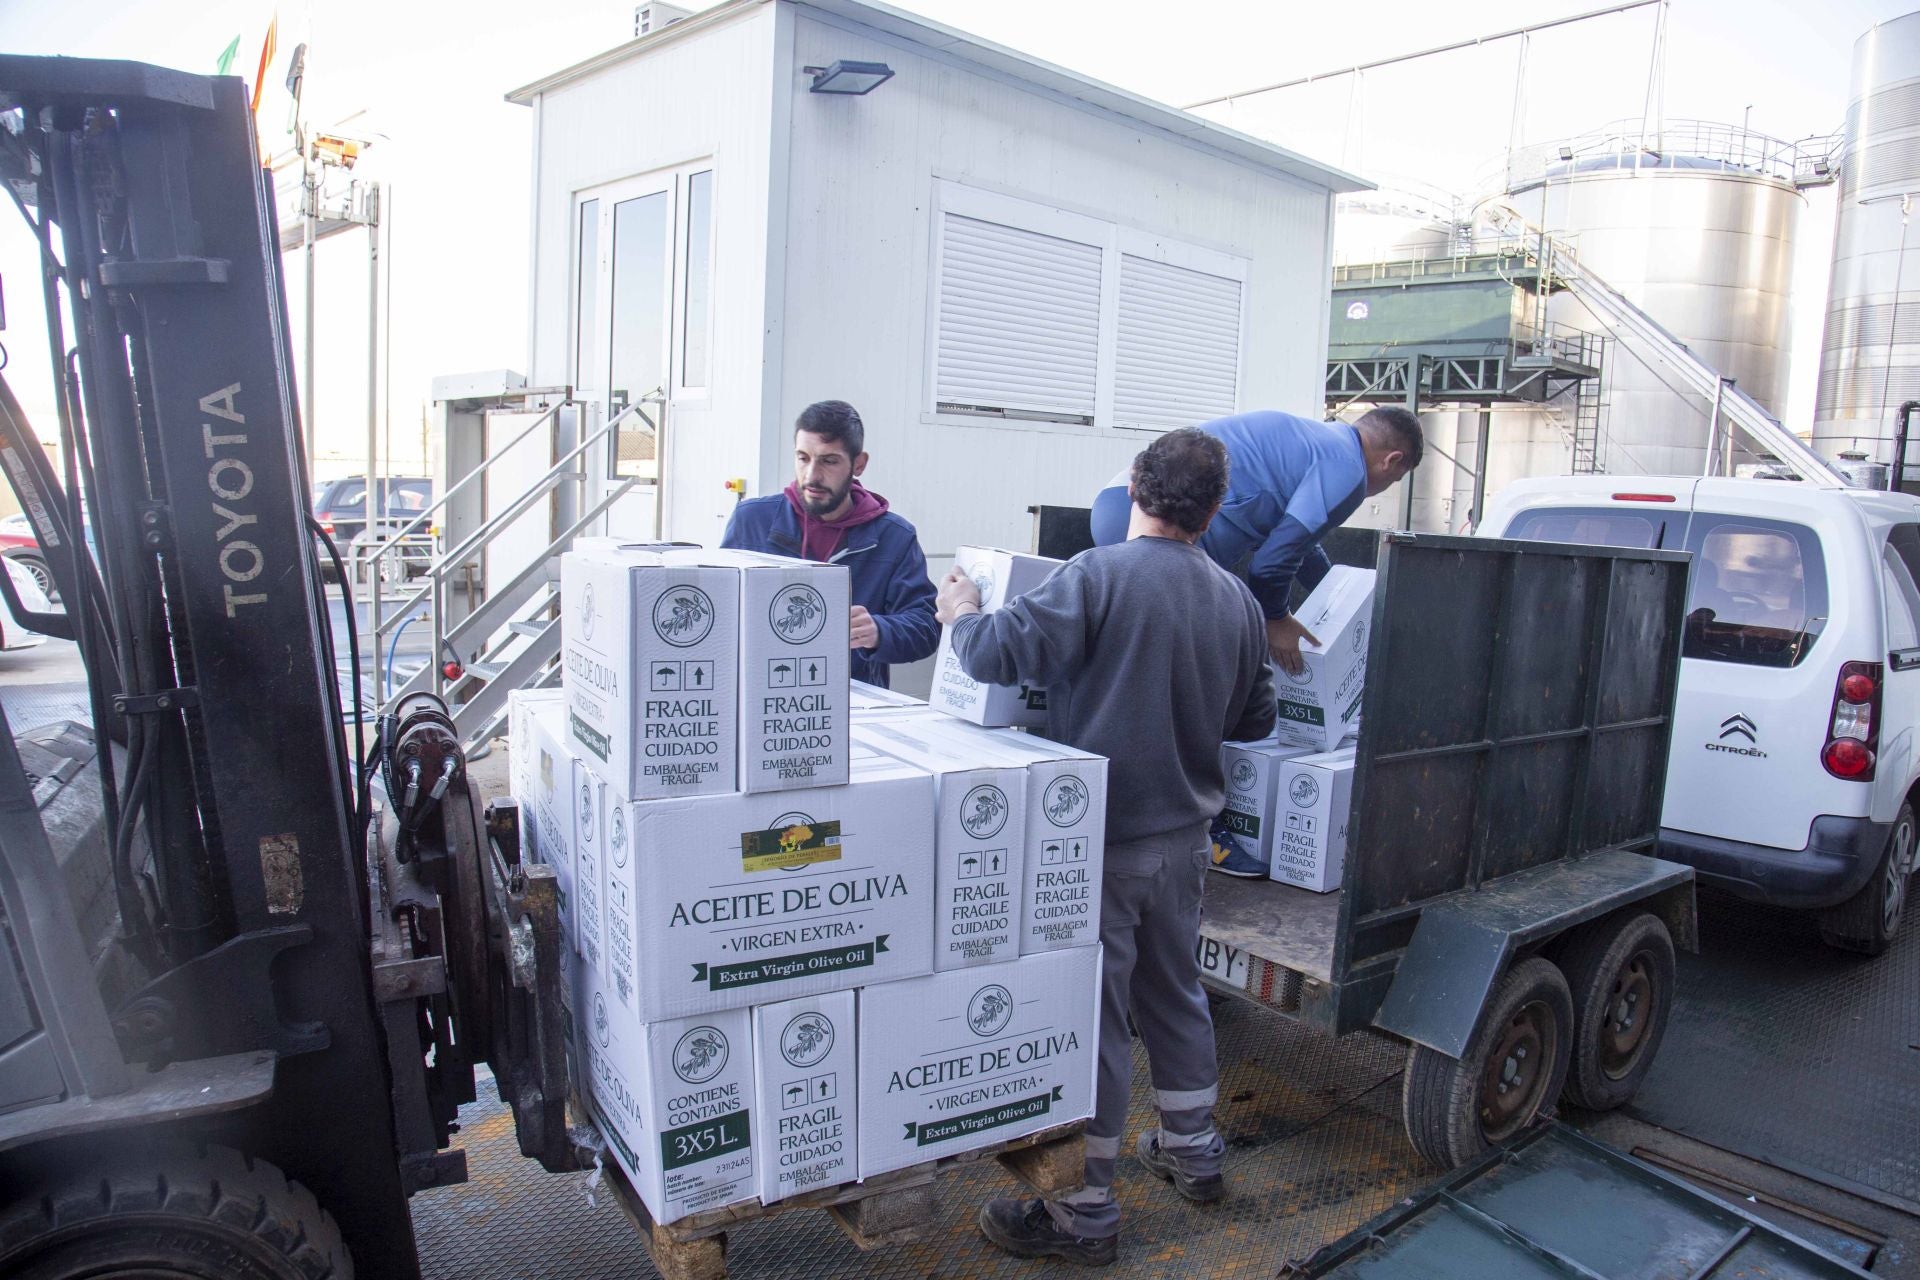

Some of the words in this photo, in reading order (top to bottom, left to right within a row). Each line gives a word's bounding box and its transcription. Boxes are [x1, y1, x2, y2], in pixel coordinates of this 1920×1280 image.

[199, 382, 269, 619] TOYOTA
[595, 664, 618, 697] OLIVA
[943, 672, 978, 690] CUIDADO
[1335, 665, 1357, 704] ACEITE
[1281, 685, 1318, 698] CONTIENE
[1281, 693, 1319, 705] CONTAINS
[645, 699, 718, 718] FRAGIL
[763, 695, 832, 714] FRAGIL
[1284, 705, 1305, 718] 3X5
[645, 721, 718, 738] FRAGILE
[763, 716, 831, 734] FRAGILE
[645, 741, 717, 757] CUIDADO
[763, 735, 831, 752] CUIDADO
[644, 762, 719, 775] EMBALAGEM
[762, 755, 832, 770] EMBALAGEM
[661, 773, 702, 785] FRAGIL
[778, 766, 817, 779] FRAGIL
[1282, 832, 1317, 848] FRAGIL
[1281, 843, 1316, 859] FRAGILE
[1280, 854, 1315, 868] CUIDADO
[1036, 869, 1090, 887] FRAGIL
[1279, 865, 1315, 878] EMBALAGEM
[669, 892, 775, 928] ACEITE
[783, 886, 821, 913] DE
[829, 874, 908, 906] OLIVA
[953, 883, 1010, 902] FRAGIL
[1035, 887, 1089, 904] FRAGILE
[952, 901, 1009, 919] FRAGILE
[1034, 903, 1088, 919] CUIDADO
[610, 907, 631, 942] FRAGIL
[952, 918, 1008, 935] CUIDADO
[1032, 920, 1088, 935] EMBALAGEM
[610, 927, 632, 961] FRAGILE
[730, 929, 796, 952] VIRGEN
[801, 921, 856, 942] EXTRA
[950, 935, 1008, 951] EMBALAGEM
[1044, 931, 1075, 942] FRAGIL
[963, 947, 995, 959] FRAGIL
[720, 969, 758, 984] Extra
[761, 962, 804, 977] Virgin
[809, 955, 843, 969] Olive
[846, 950, 865, 962] Oil
[887, 1057, 973, 1094] ACEITE
[980, 1048, 1011, 1073] DE
[1016, 1032, 1079, 1063] OLIVA
[600, 1058, 614, 1091] DE
[614, 1078, 643, 1129] OLIVA
[668, 1082, 739, 1111] CONTIENE
[936, 1087, 990, 1111] VIRGEN
[993, 1078, 1036, 1097] EXTRA
[669, 1098, 740, 1126] CONTAINS
[779, 1106, 842, 1133] FRAGIL
[925, 1125, 958, 1139] Extra
[961, 1116, 994, 1130] Virgin
[998, 1107, 1026, 1121] Olive
[1028, 1101, 1043, 1114] Oil
[675, 1127, 716, 1159] 3X5
[780, 1124, 842, 1151] FRAGILE
[780, 1141, 842, 1166] CUIDADO
[666, 1173, 684, 1183] lote:
[779, 1158, 844, 1182] EMBALAGEM
[794, 1172, 830, 1187] FRAGIL
[683, 1193, 709, 1203] PRODUCTO
